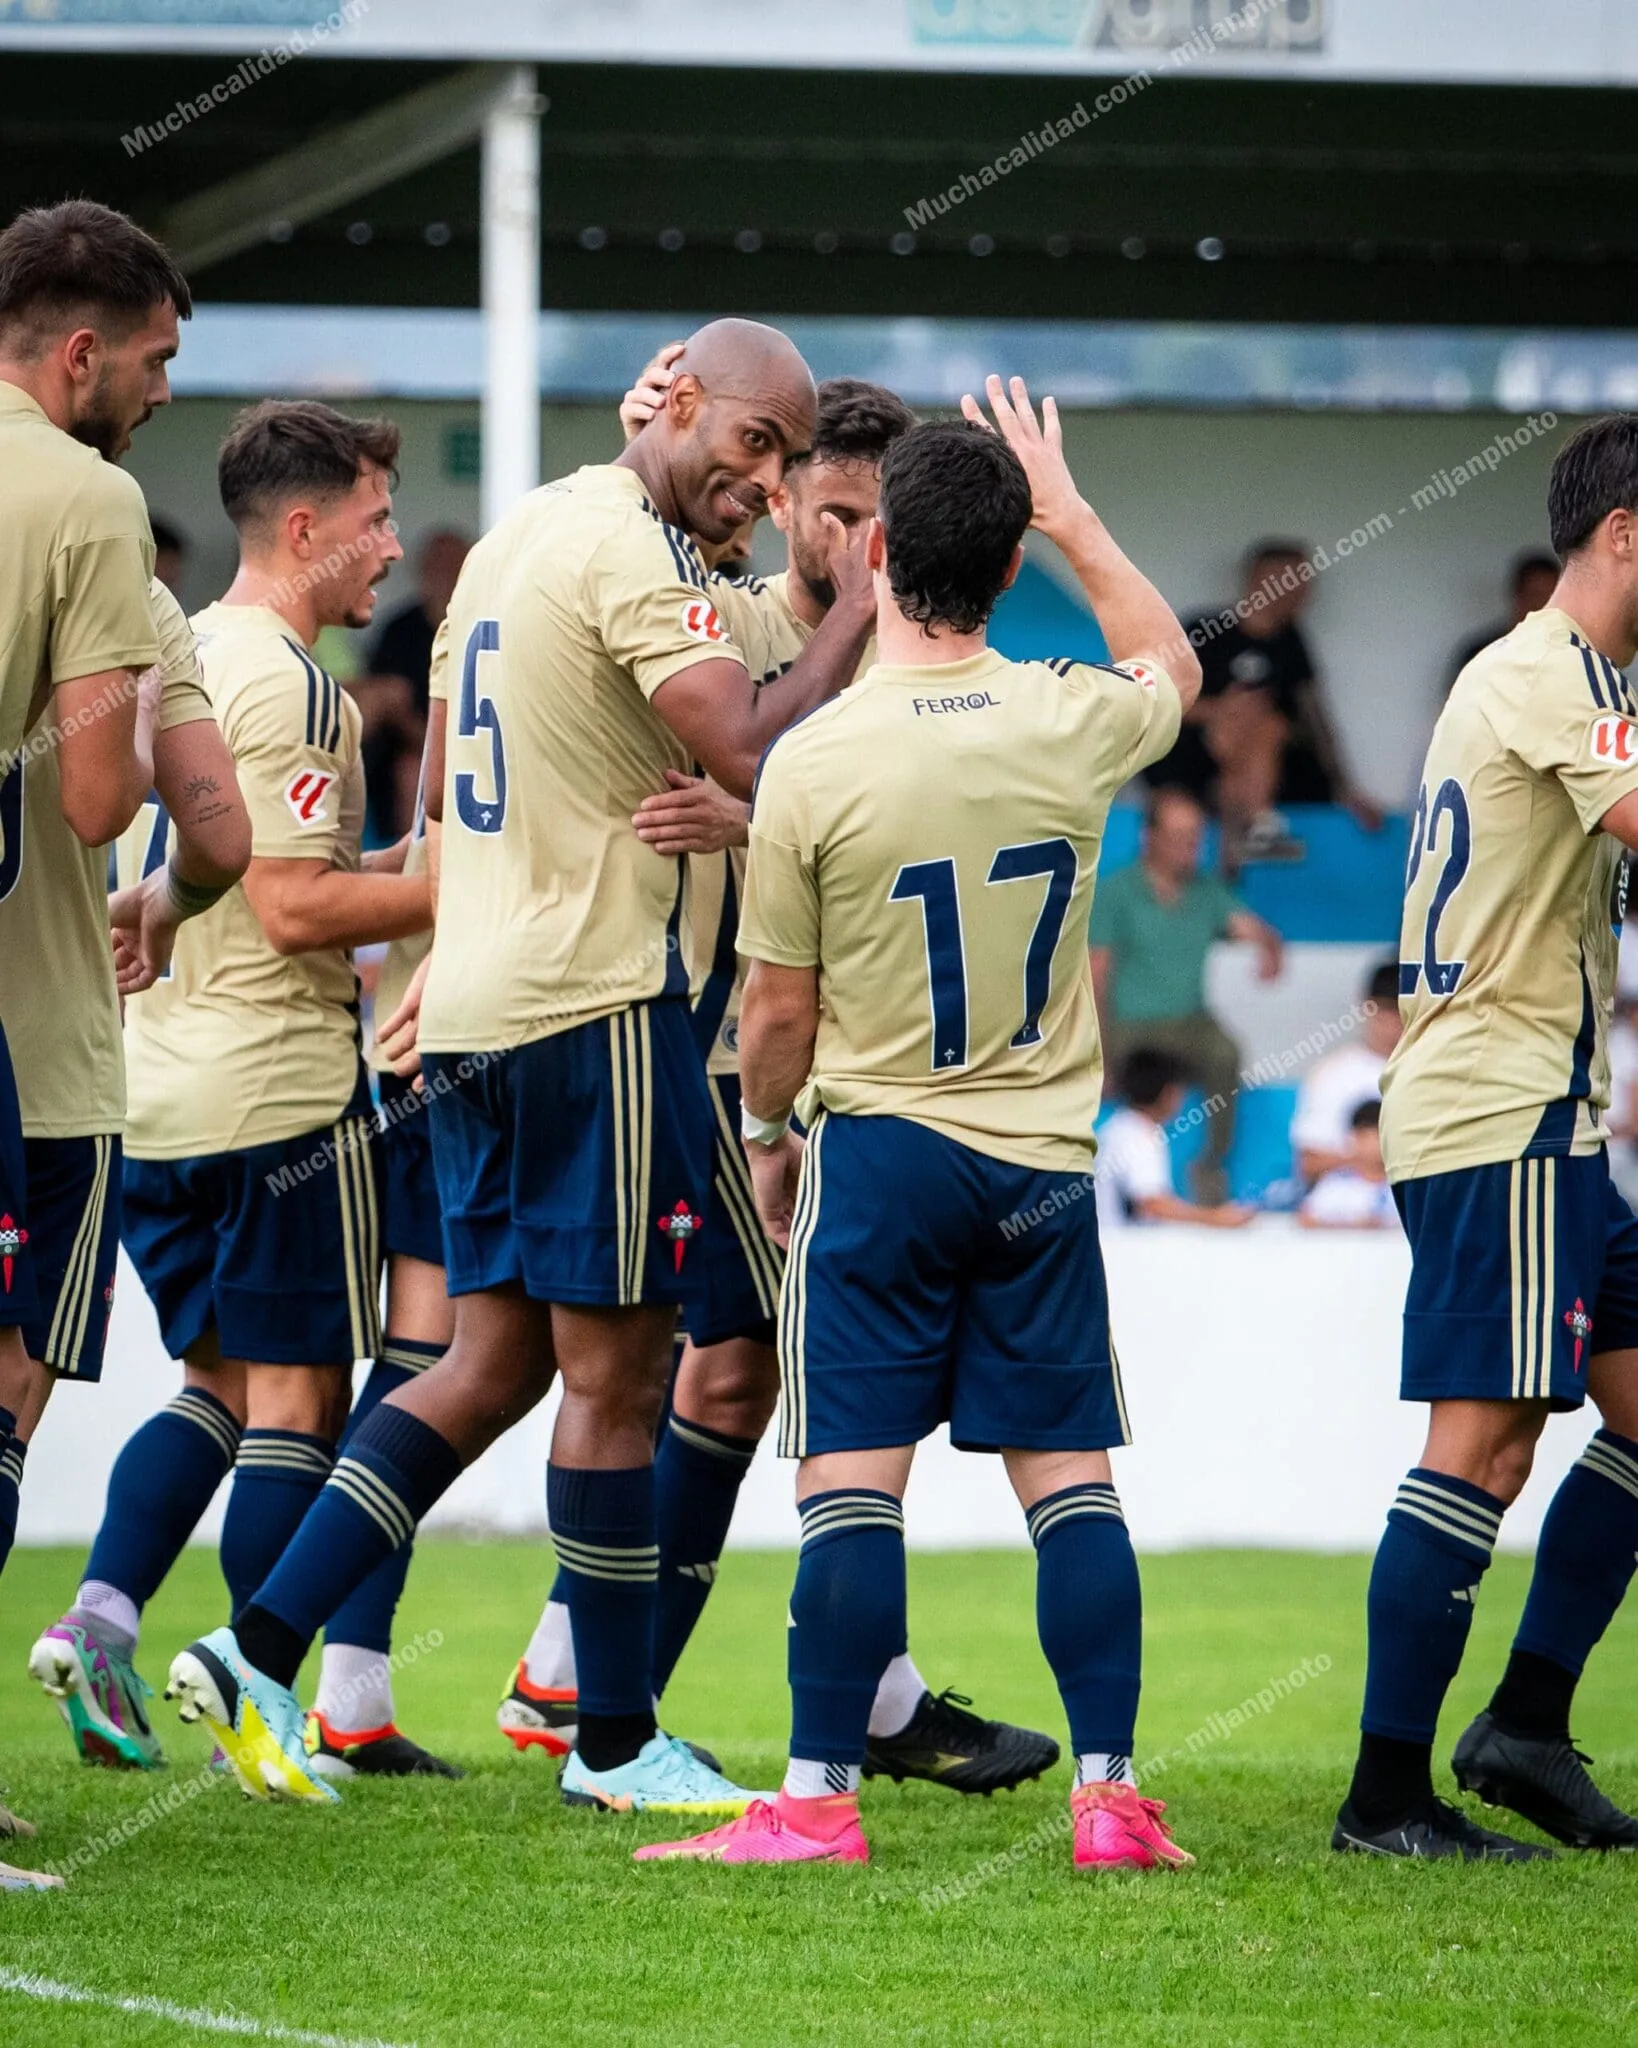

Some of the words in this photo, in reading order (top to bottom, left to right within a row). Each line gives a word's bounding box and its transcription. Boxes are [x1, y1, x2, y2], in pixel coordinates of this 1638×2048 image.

[455, 619, 507, 835] 5
[911, 690, 1001, 716] FERROL
[887, 836, 1078, 1072] 17
